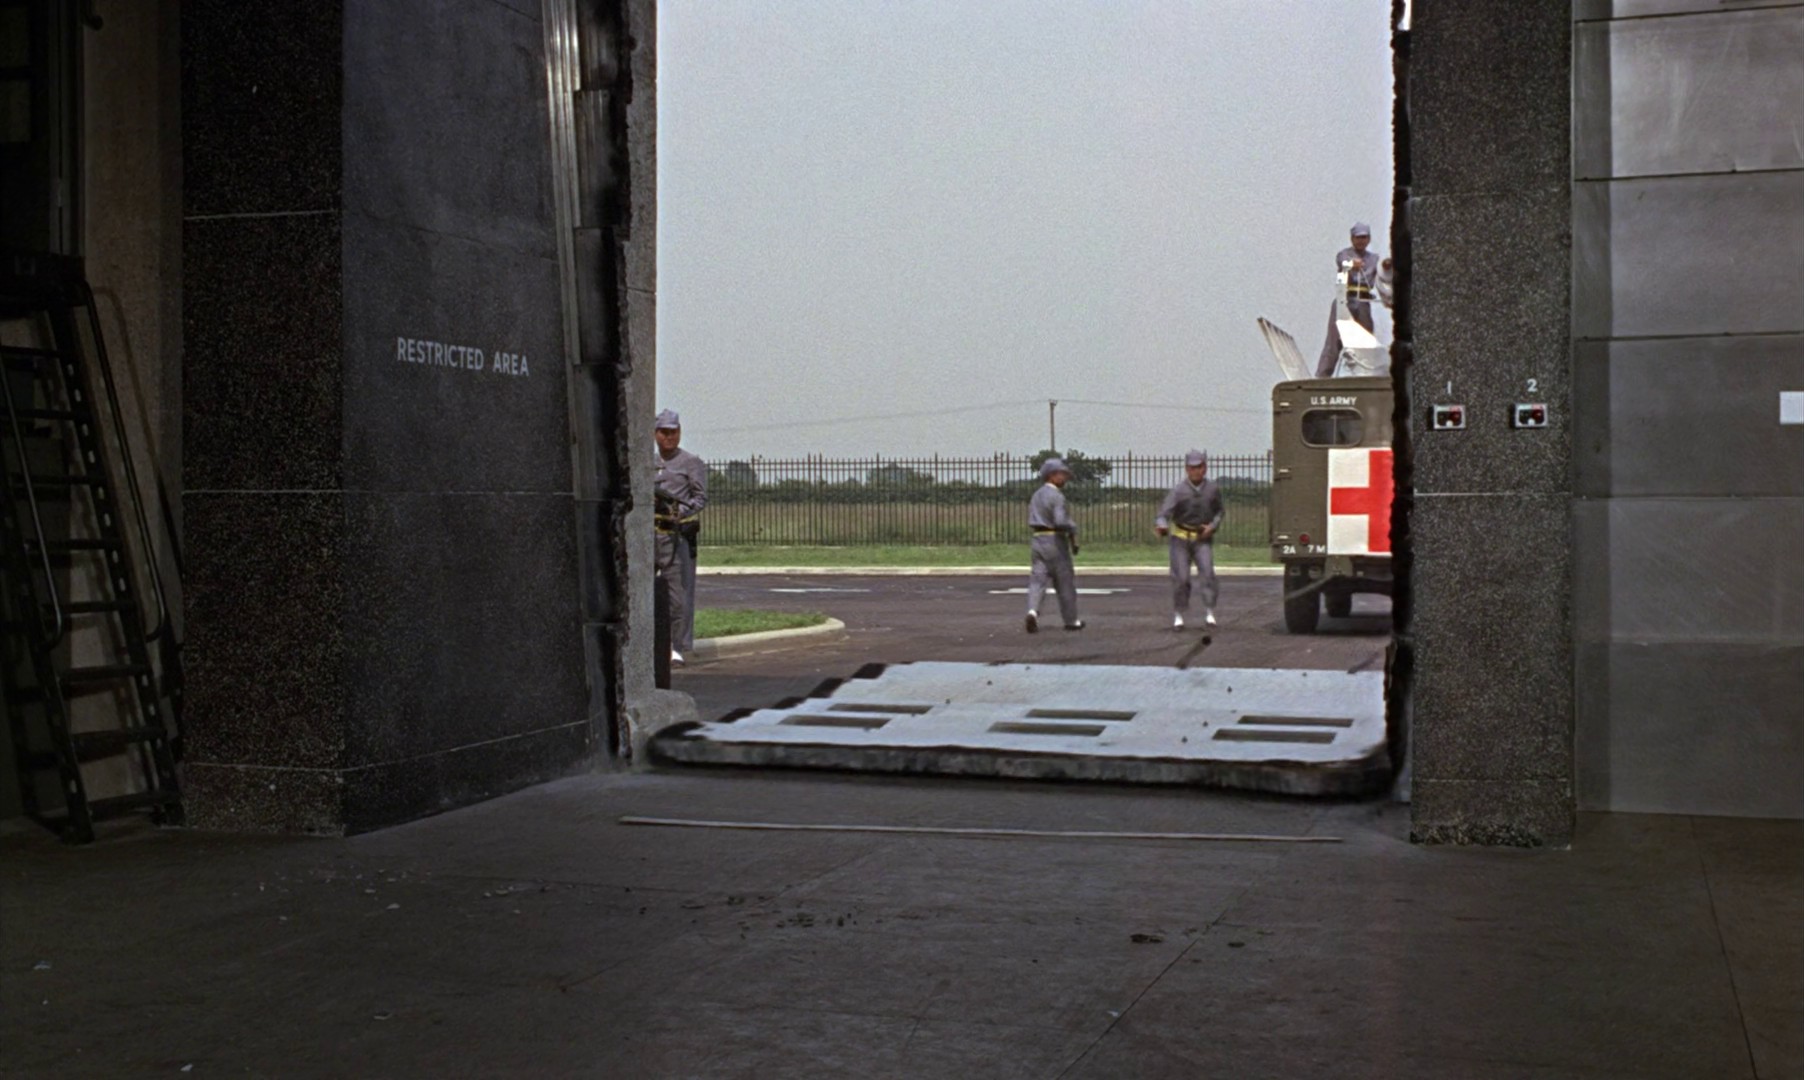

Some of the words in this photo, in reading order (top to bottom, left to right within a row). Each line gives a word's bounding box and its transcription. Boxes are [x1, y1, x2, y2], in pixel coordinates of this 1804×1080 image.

[397, 337, 484, 370] RESTRICTED
[493, 351, 530, 376] AREA
[1527, 378, 1538, 393] 2
[1329, 396, 1357, 405] ARMY
[1282, 544, 1297, 554] 2A
